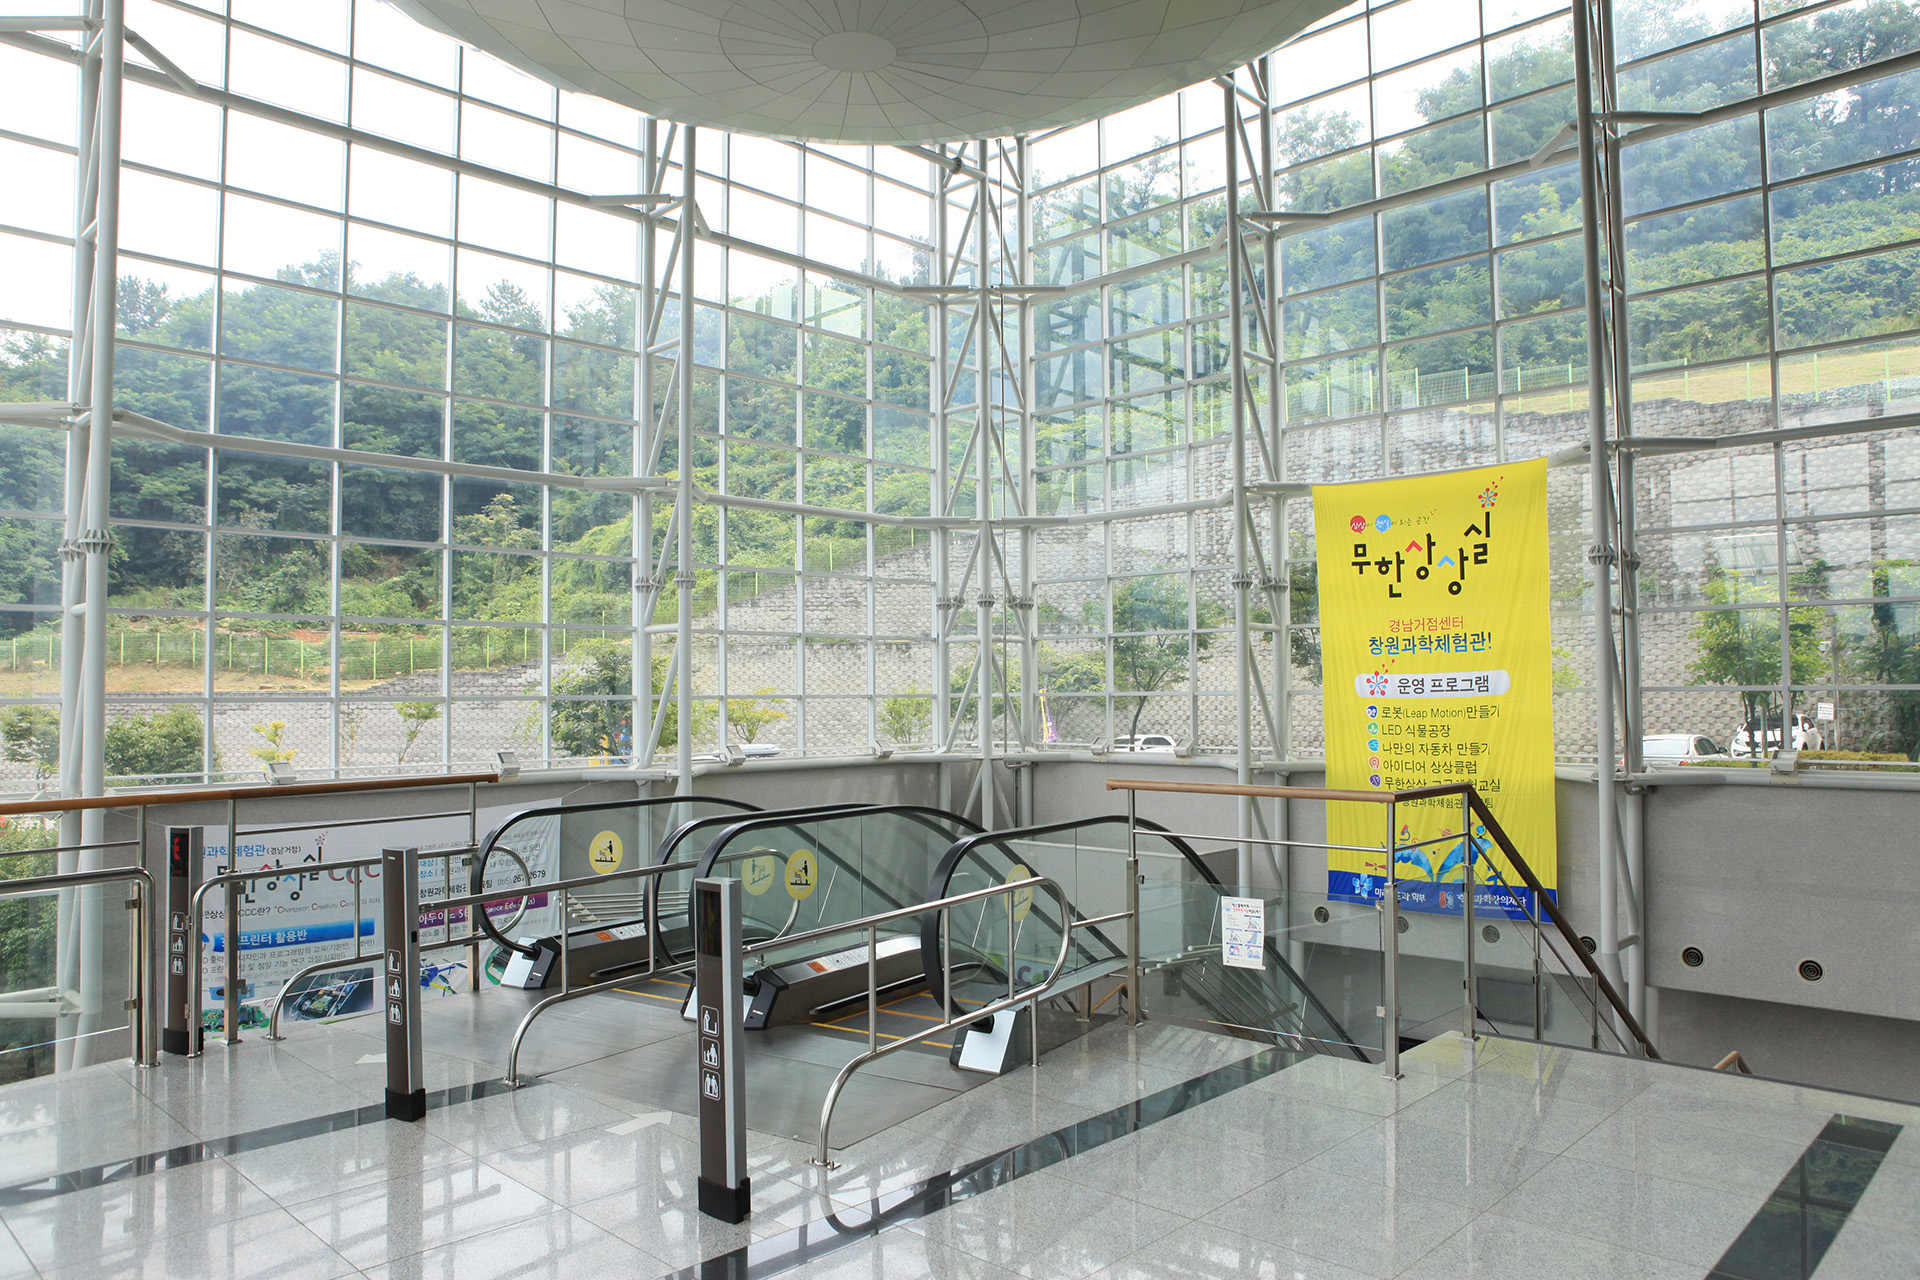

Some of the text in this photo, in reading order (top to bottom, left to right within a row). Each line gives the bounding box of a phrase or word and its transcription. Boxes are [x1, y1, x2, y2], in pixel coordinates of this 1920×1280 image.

[1351, 511, 1491, 598] 무한상상실
[1389, 615, 1464, 633] 경남거점센터
[1368, 632, 1493, 656] 창원과학체험관!
[1397, 675, 1490, 695] 운영 프로그램
[1381, 703, 1500, 720] 로봇(Leap Motion)만들기
[1381, 724, 1451, 738] LED 식물공장
[1382, 742, 1490, 757] 나만의 자동차 만들기
[1383, 760, 1477, 775] 아이디어 상상클럽
[275, 929, 308, 944] 활용반
